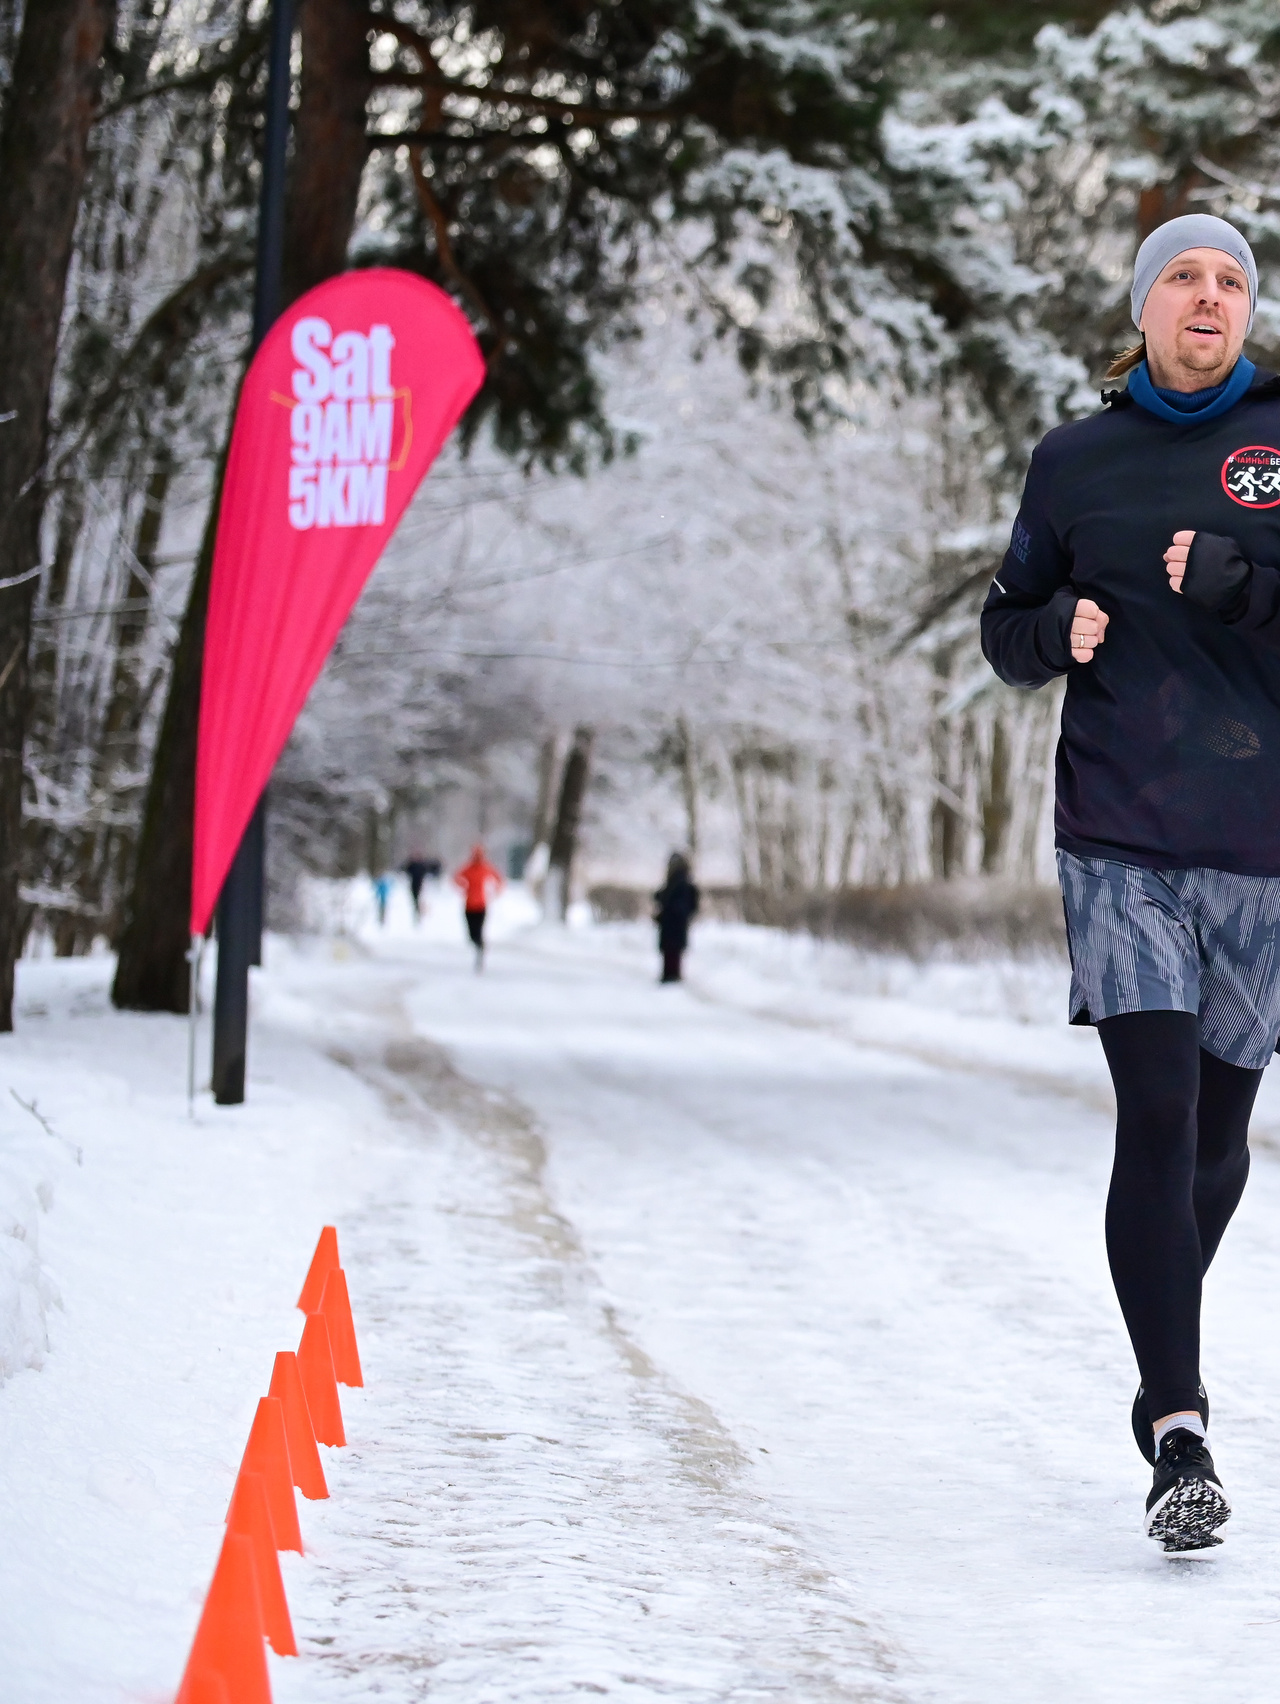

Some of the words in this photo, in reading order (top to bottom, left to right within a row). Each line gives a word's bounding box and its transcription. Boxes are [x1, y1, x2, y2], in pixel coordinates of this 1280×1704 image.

[291, 316, 395, 401] Sat
[290, 401, 394, 464] 9AM
[288, 464, 389, 530] 5KM
